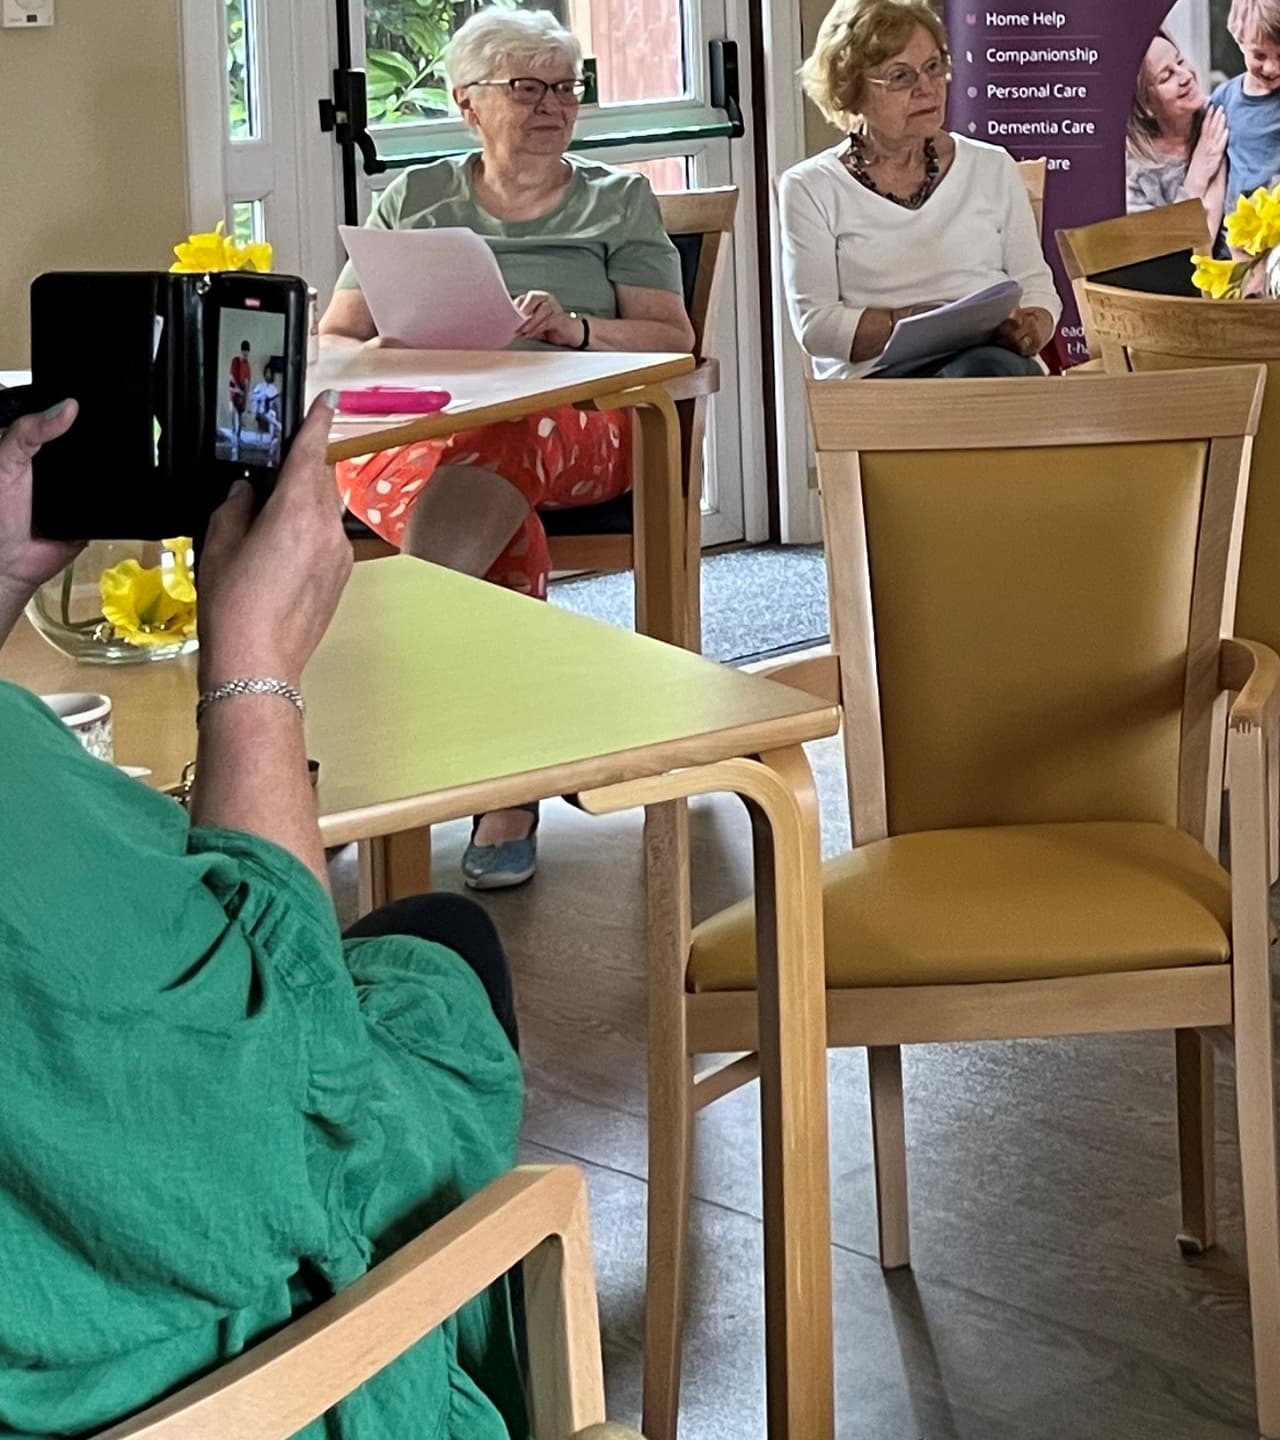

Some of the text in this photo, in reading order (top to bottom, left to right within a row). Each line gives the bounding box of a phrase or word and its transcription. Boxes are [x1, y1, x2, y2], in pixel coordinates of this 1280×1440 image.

[985, 11, 1066, 29] Home Help
[985, 47, 1098, 66] Companionship
[986, 83, 1087, 99] Personal Care
[987, 120, 1095, 135] Dementia Care
[1046, 158, 1071, 171] are
